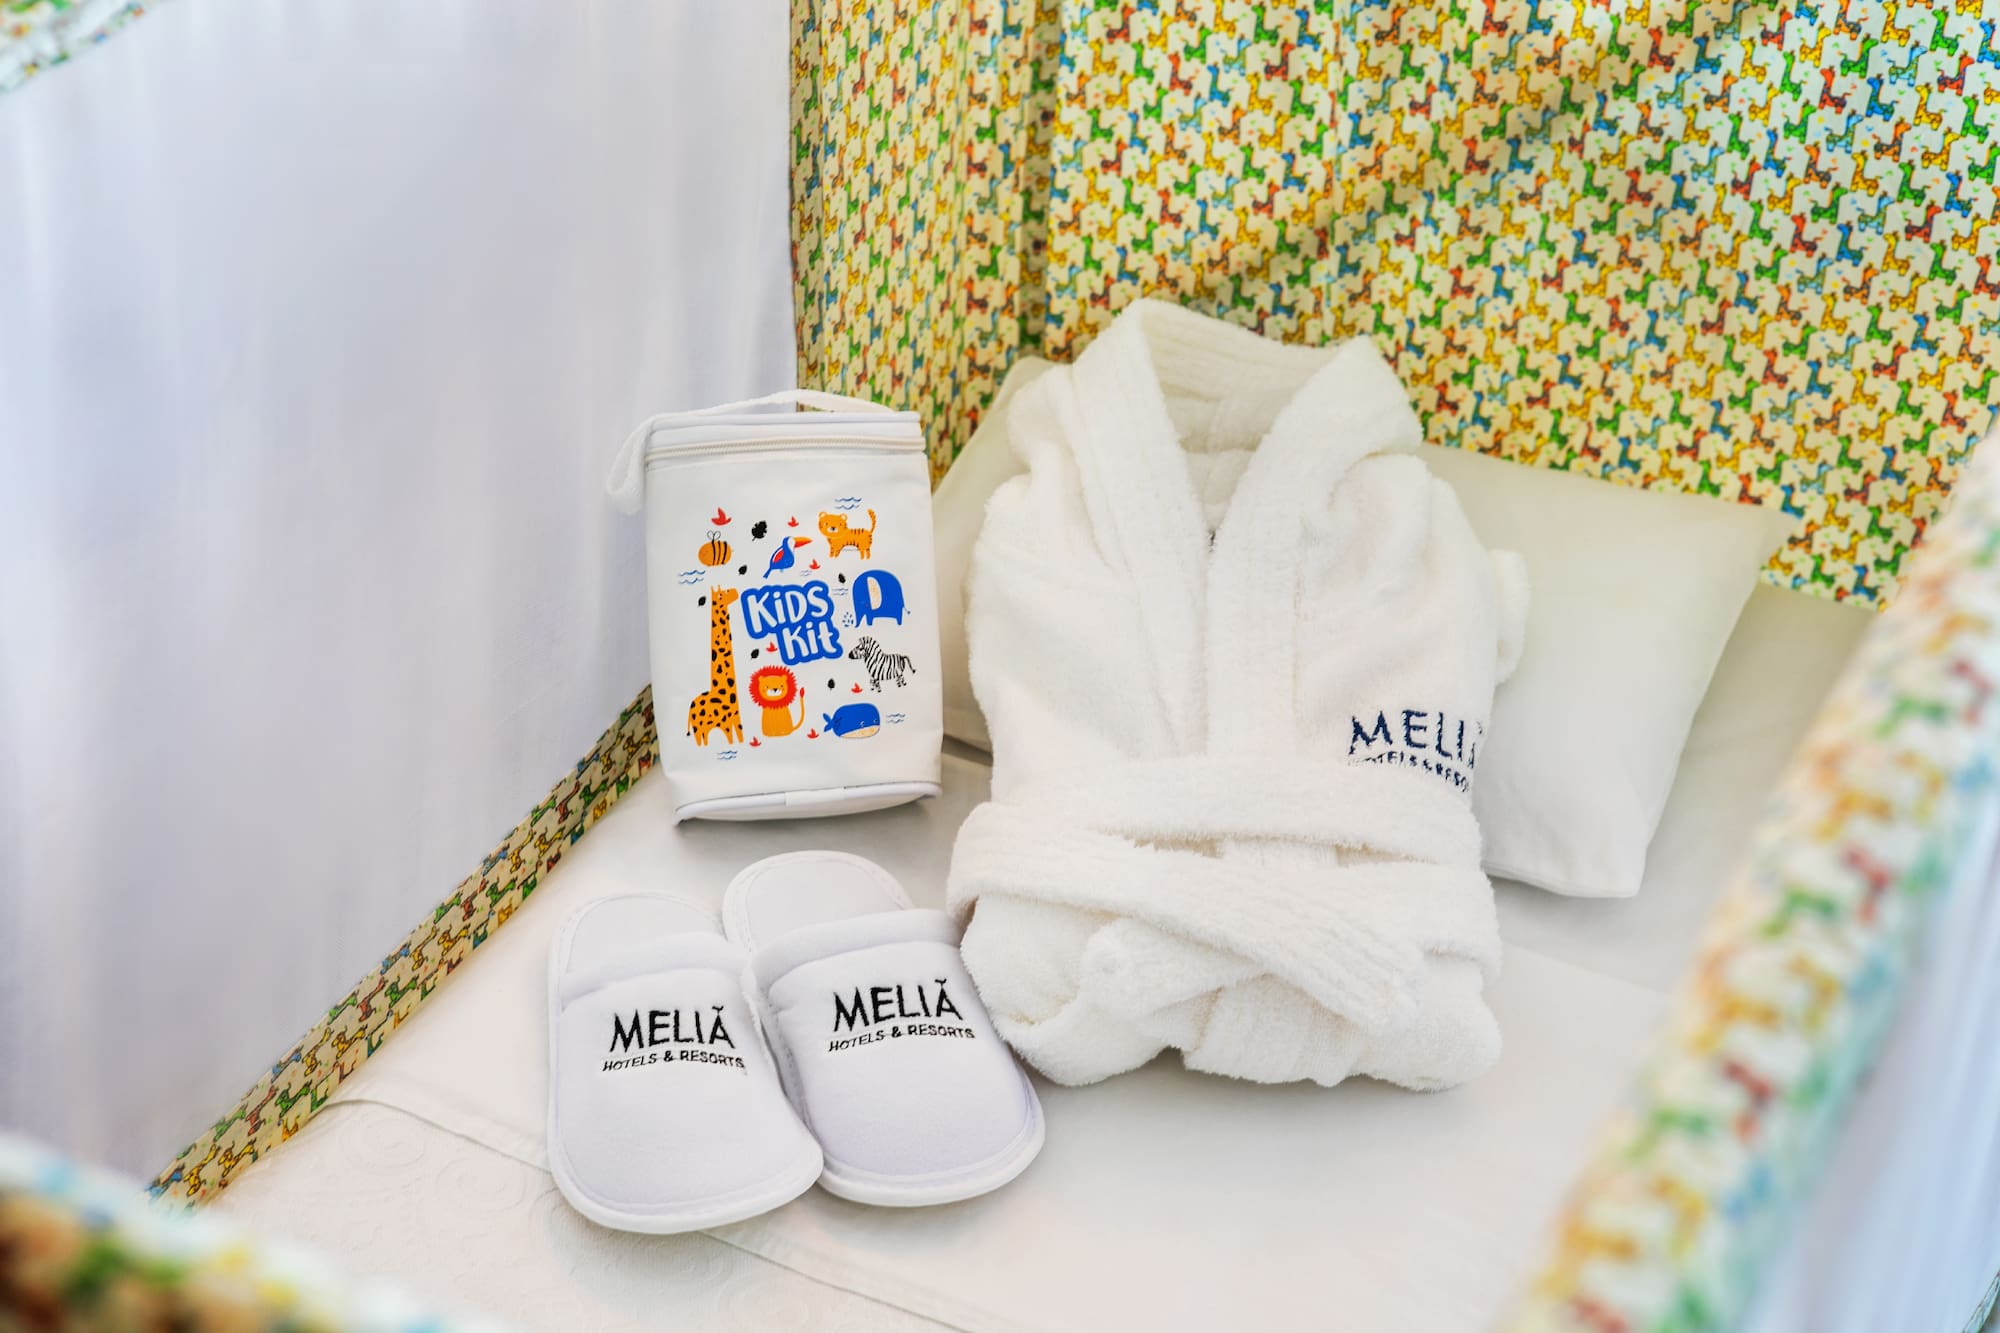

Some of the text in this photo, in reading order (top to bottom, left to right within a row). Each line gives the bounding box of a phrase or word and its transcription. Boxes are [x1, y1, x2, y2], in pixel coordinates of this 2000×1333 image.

[782, 621, 837, 660] Kit
[828, 1023, 976, 1053] HOTELS & RESORTS
[602, 1049, 745, 1072] HOTELS & RESORTS
